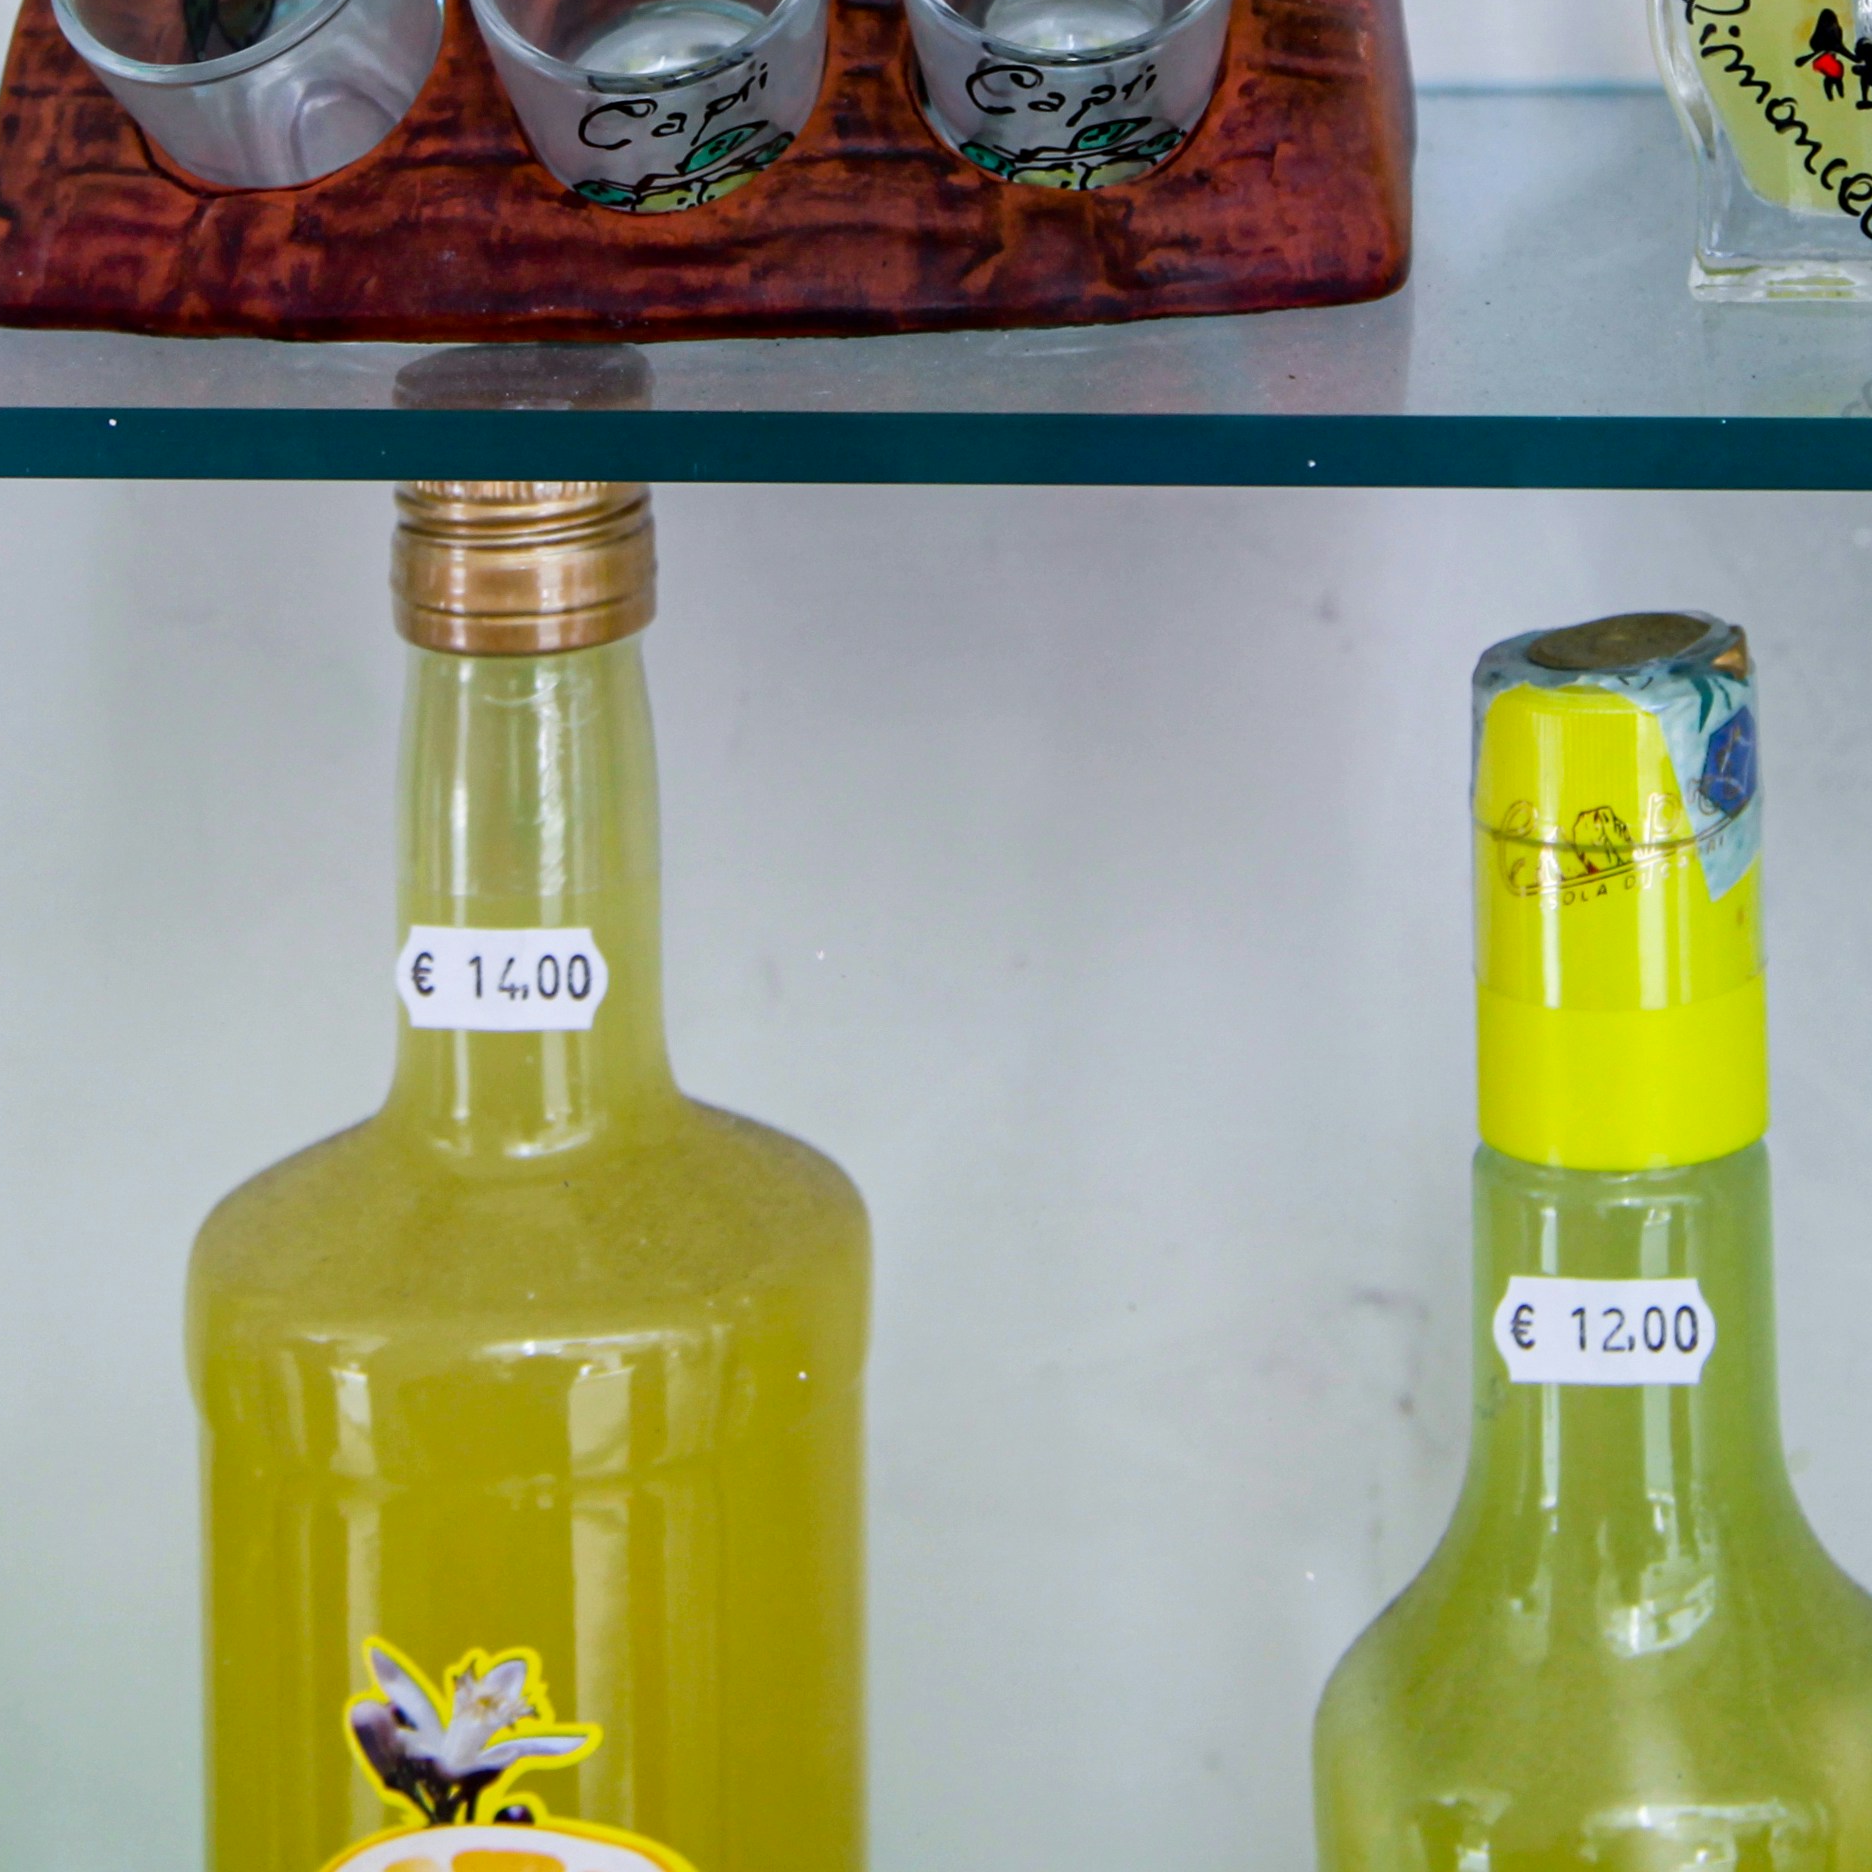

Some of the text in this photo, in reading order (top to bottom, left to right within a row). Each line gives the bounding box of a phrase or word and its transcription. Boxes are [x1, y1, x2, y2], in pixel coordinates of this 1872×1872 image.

[579, 62, 769, 150] Capri
[965, 64, 1157, 127] Capri
[411, 952, 435, 996] €
[1510, 1303, 1536, 1350] €
